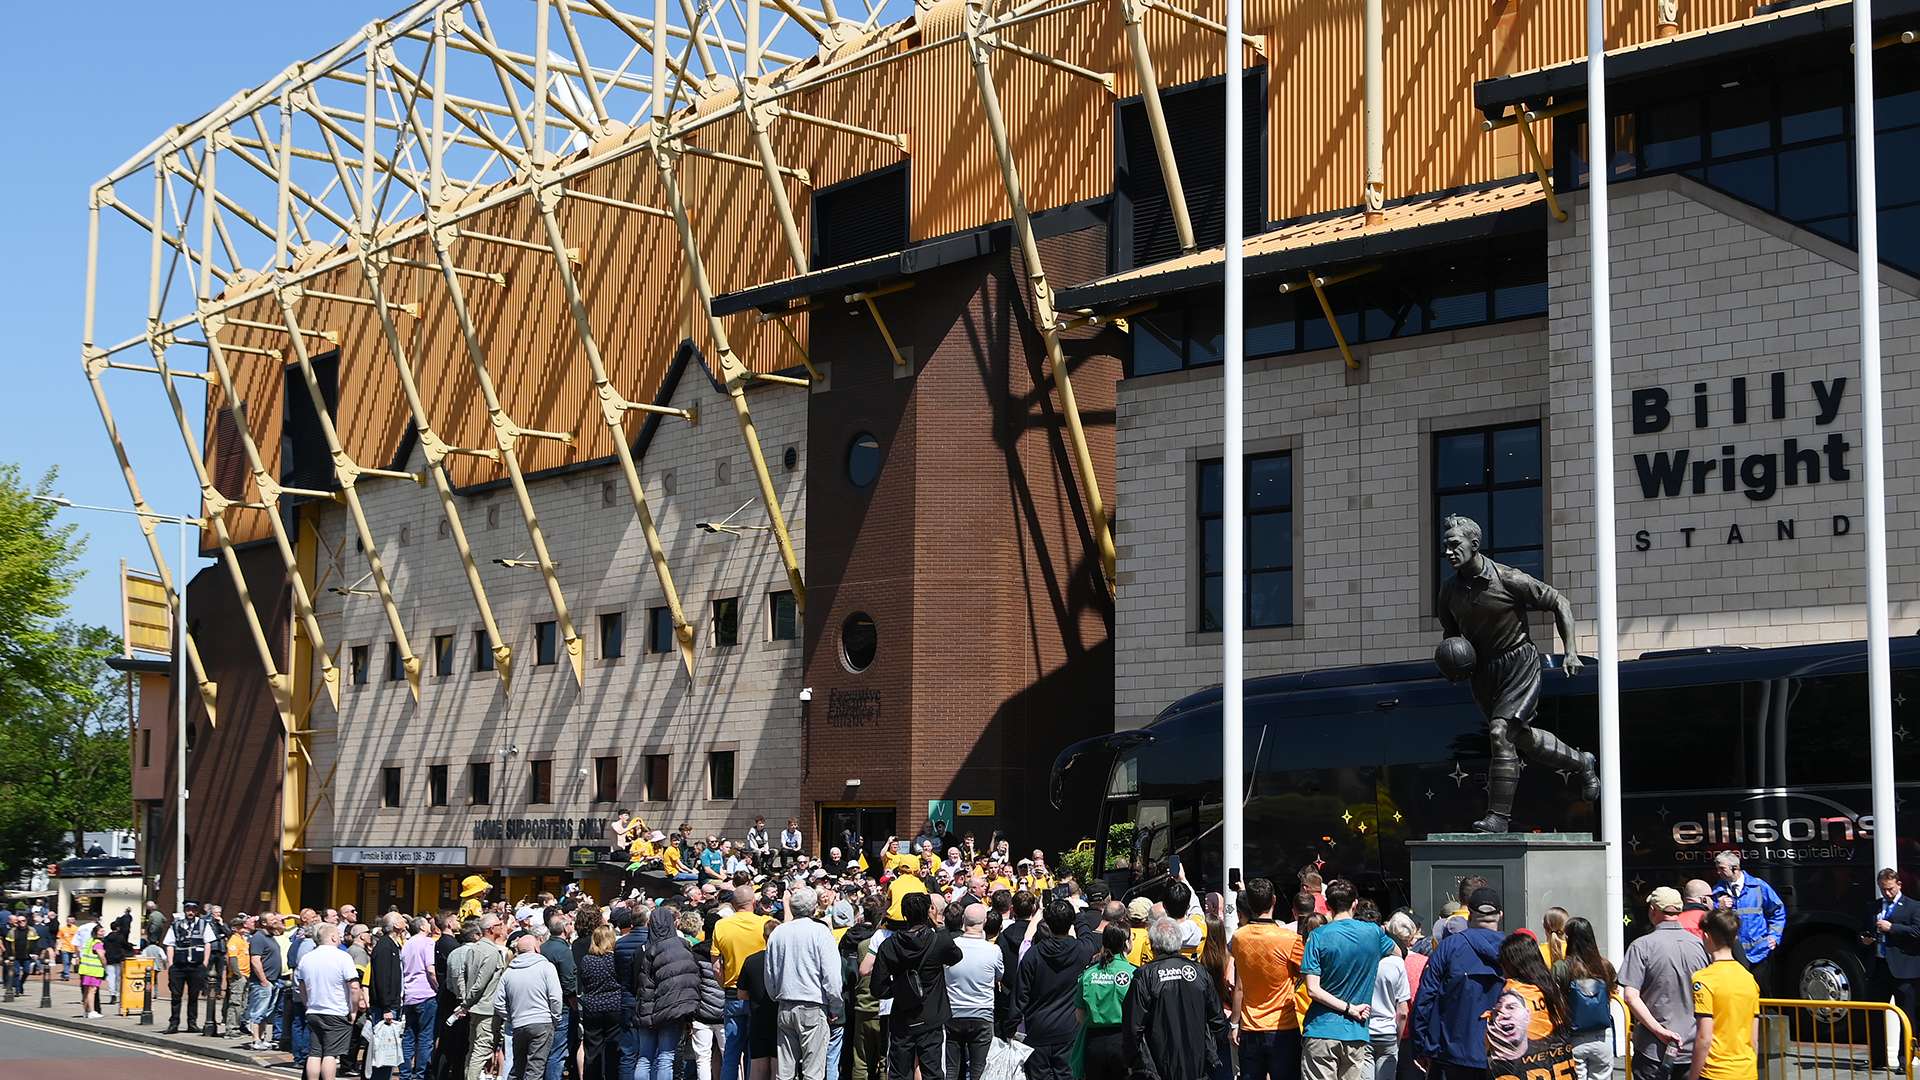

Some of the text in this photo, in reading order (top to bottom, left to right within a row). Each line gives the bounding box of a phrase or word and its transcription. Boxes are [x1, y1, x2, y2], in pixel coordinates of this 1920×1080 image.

[1632, 372, 1847, 434] Billy
[1633, 433, 1850, 500] Wright
[1635, 515, 1850, 551] STAND
[474, 818, 606, 840] HOME SUPPORTERS ONLY
[1765, 845, 1855, 860] hospitality
[1521, 1047, 1564, 1064] WE'VE
